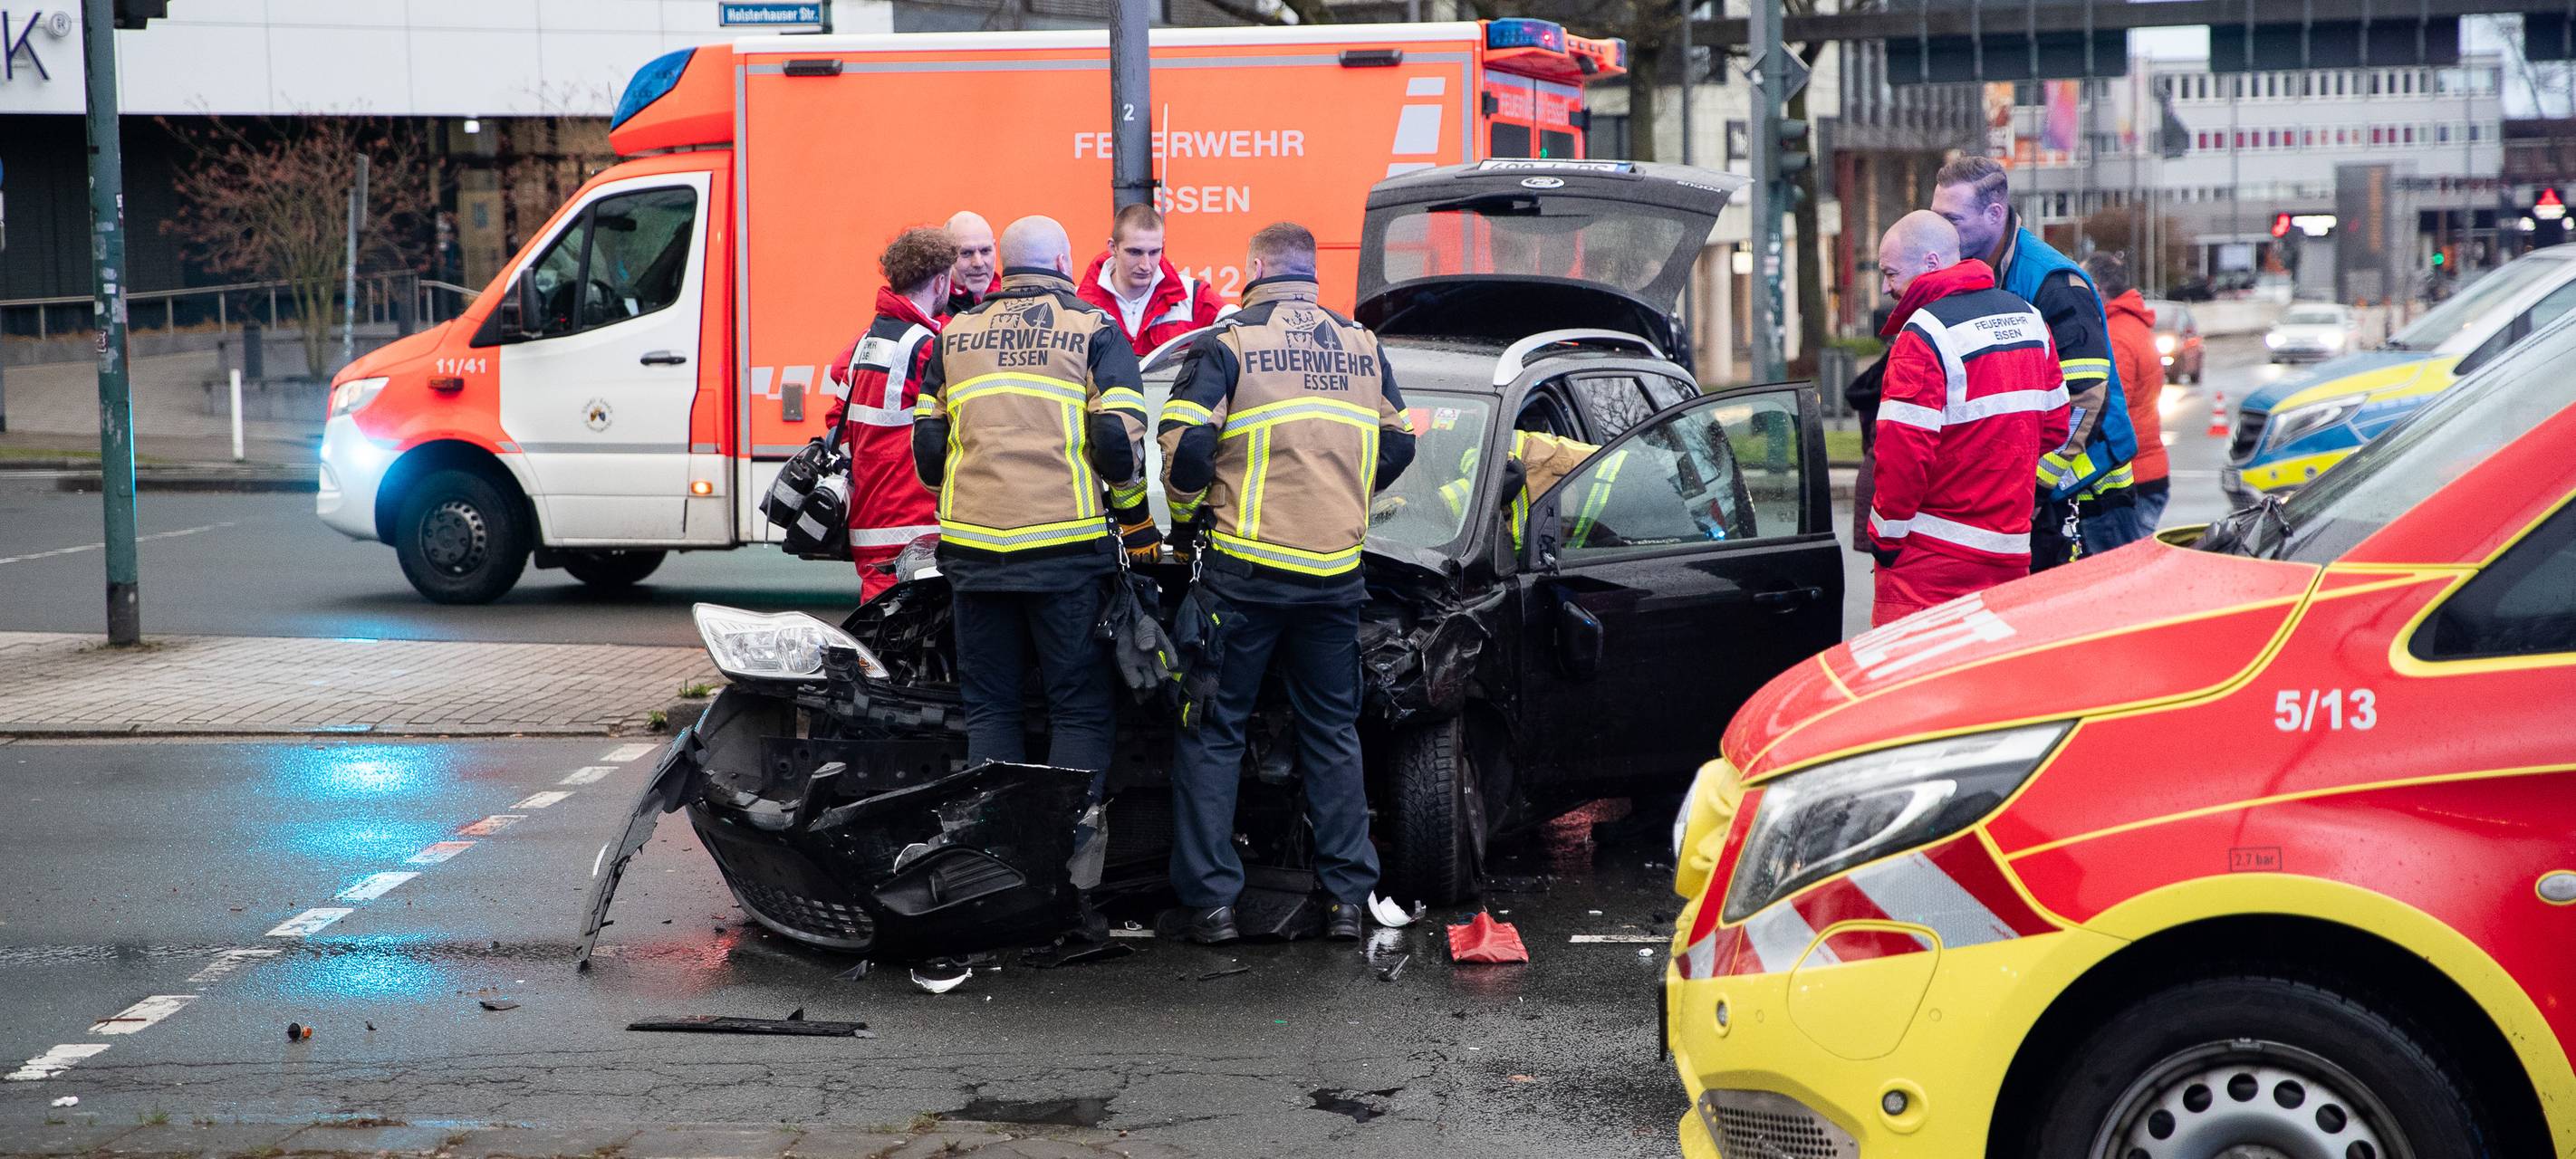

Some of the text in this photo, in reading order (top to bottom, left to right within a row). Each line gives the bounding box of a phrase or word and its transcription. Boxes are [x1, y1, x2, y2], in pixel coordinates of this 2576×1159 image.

[726, 7, 819, 22] Holsterhauser Str.
[1123, 103, 1135, 121] 2
[1074, 129, 1305, 159] FEERWEHR
[1975, 316, 2029, 330] FEUERWEHR
[946, 328, 1085, 355] FEUERWEHR
[1994, 329, 2022, 340] ESSEN
[998, 350, 1048, 367] ESSEN
[1245, 350, 1376, 377] FEUERWEHR
[436, 358, 486, 377] 11/41
[1304, 374, 1348, 391] ESSEN
[2274, 688, 2377, 732] 5/13
[2255, 854, 2274, 866] bar
